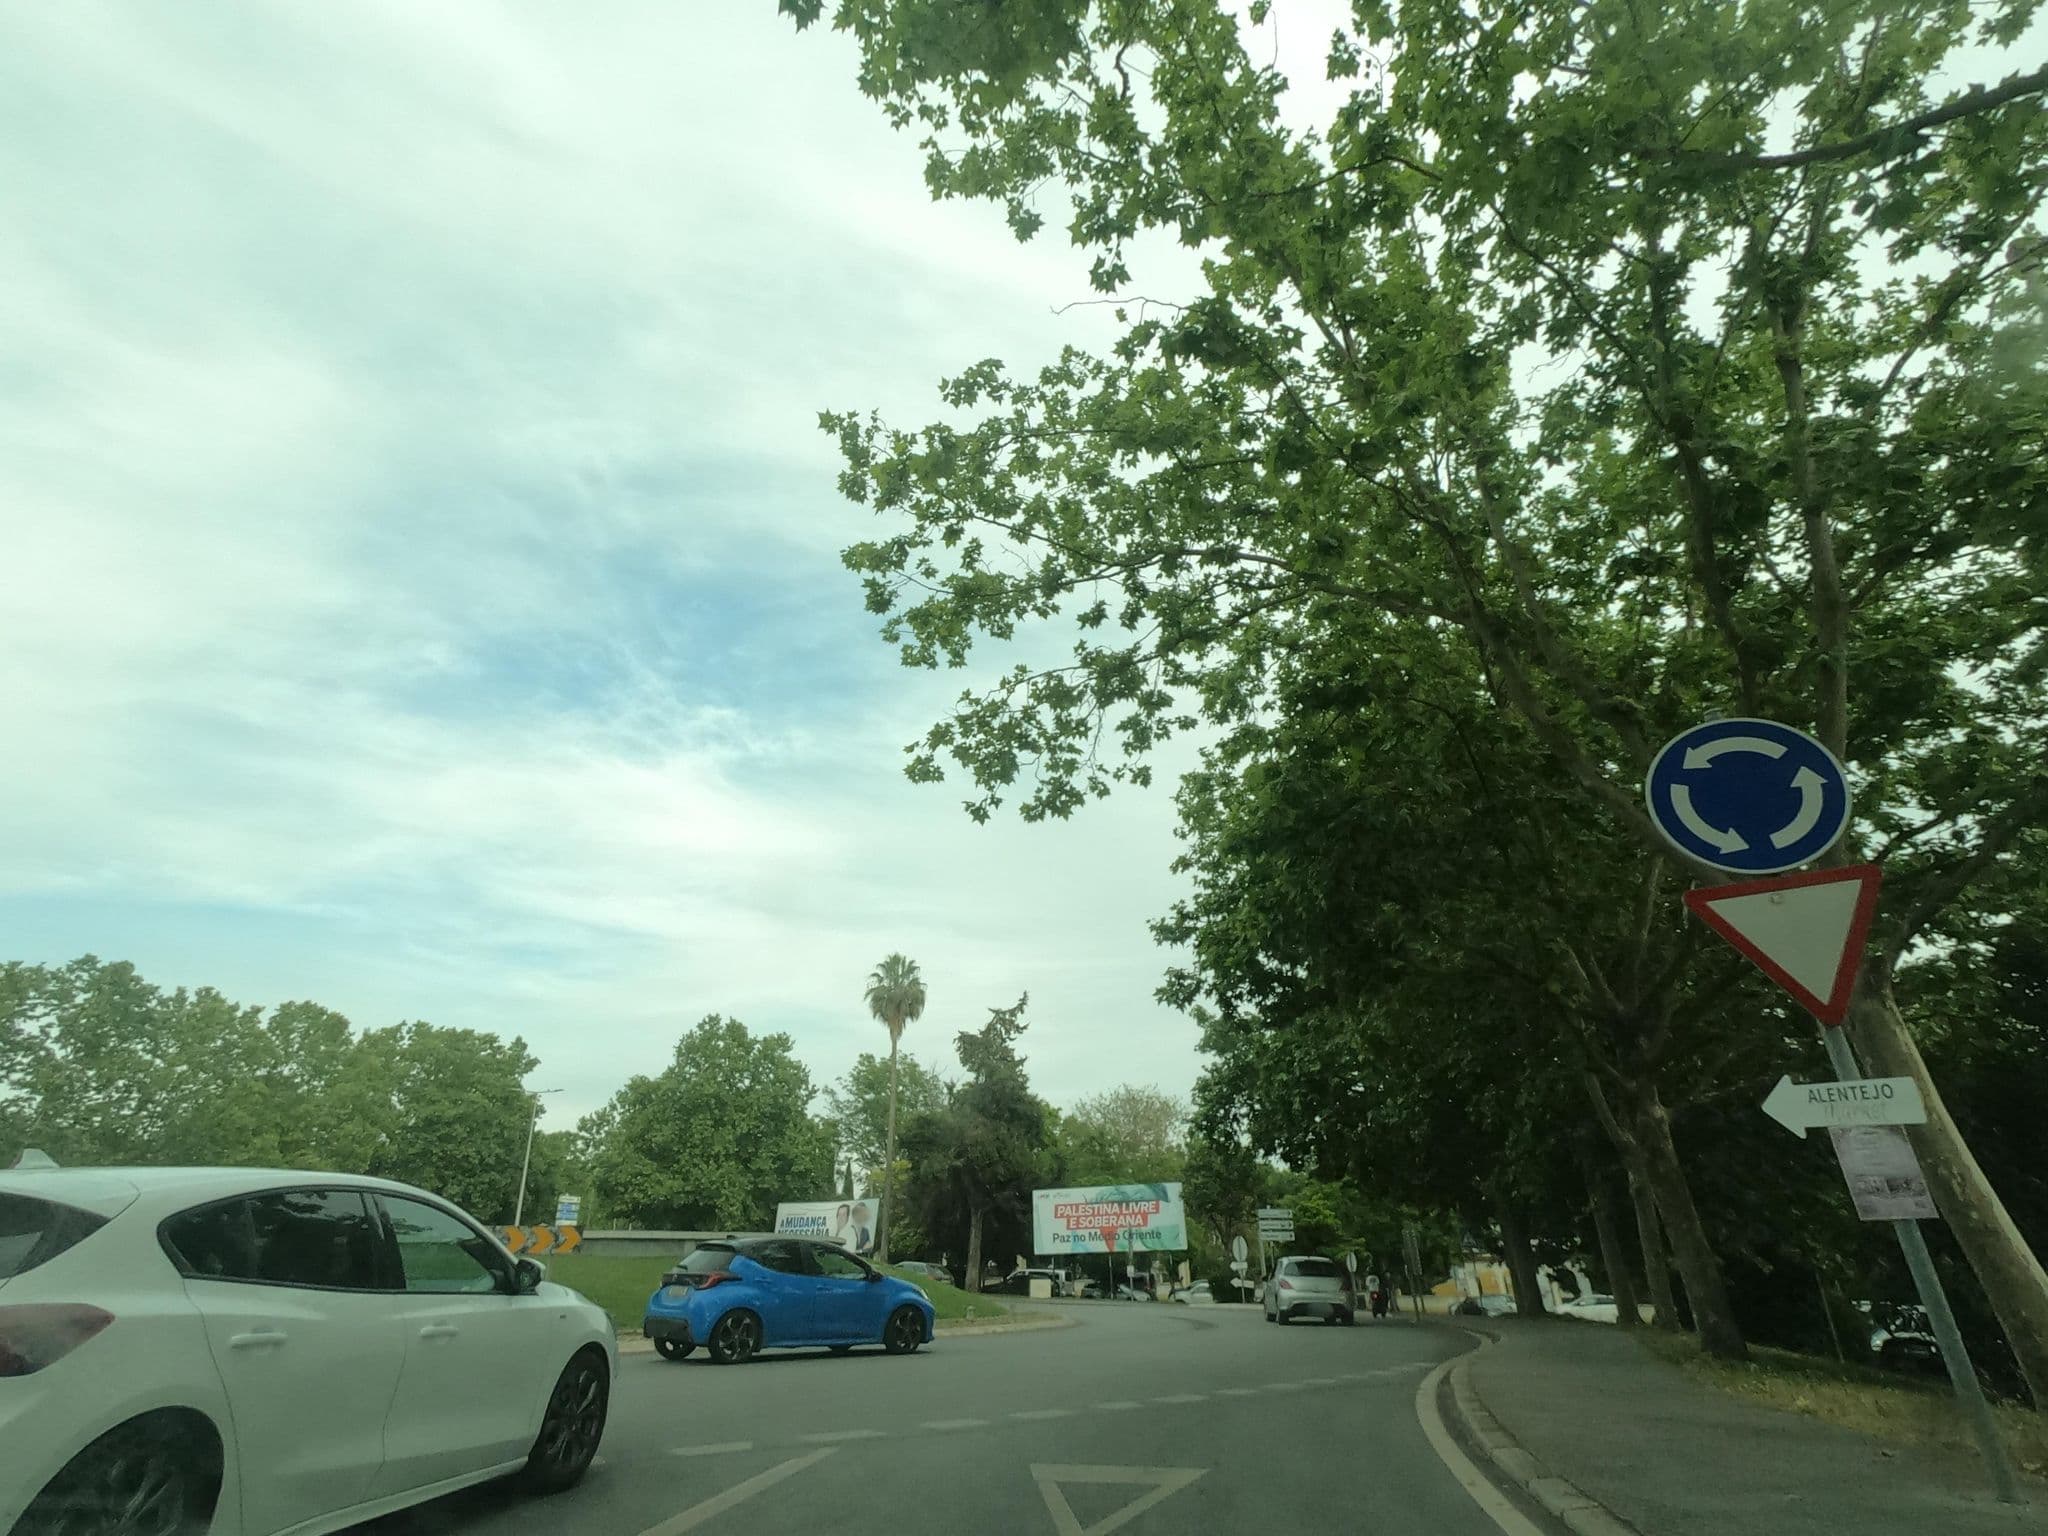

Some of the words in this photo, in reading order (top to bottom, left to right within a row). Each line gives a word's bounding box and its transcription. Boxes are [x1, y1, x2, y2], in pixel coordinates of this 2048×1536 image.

[1808, 1083, 1893, 1103] ALENTEJO
[1057, 1203, 1120, 1216] PALESTINA
[1122, 1201, 1157, 1213] LIVRE
[785, 1216, 827, 1228] MUDANÇA
[1069, 1218, 1077, 1228] E
[1080, 1215, 1144, 1228] SOBERANA
[1052, 1233, 1071, 1243] Paz
[1073, 1233, 1087, 1242] no
[1122, 1230, 1162, 1240] Oriente
